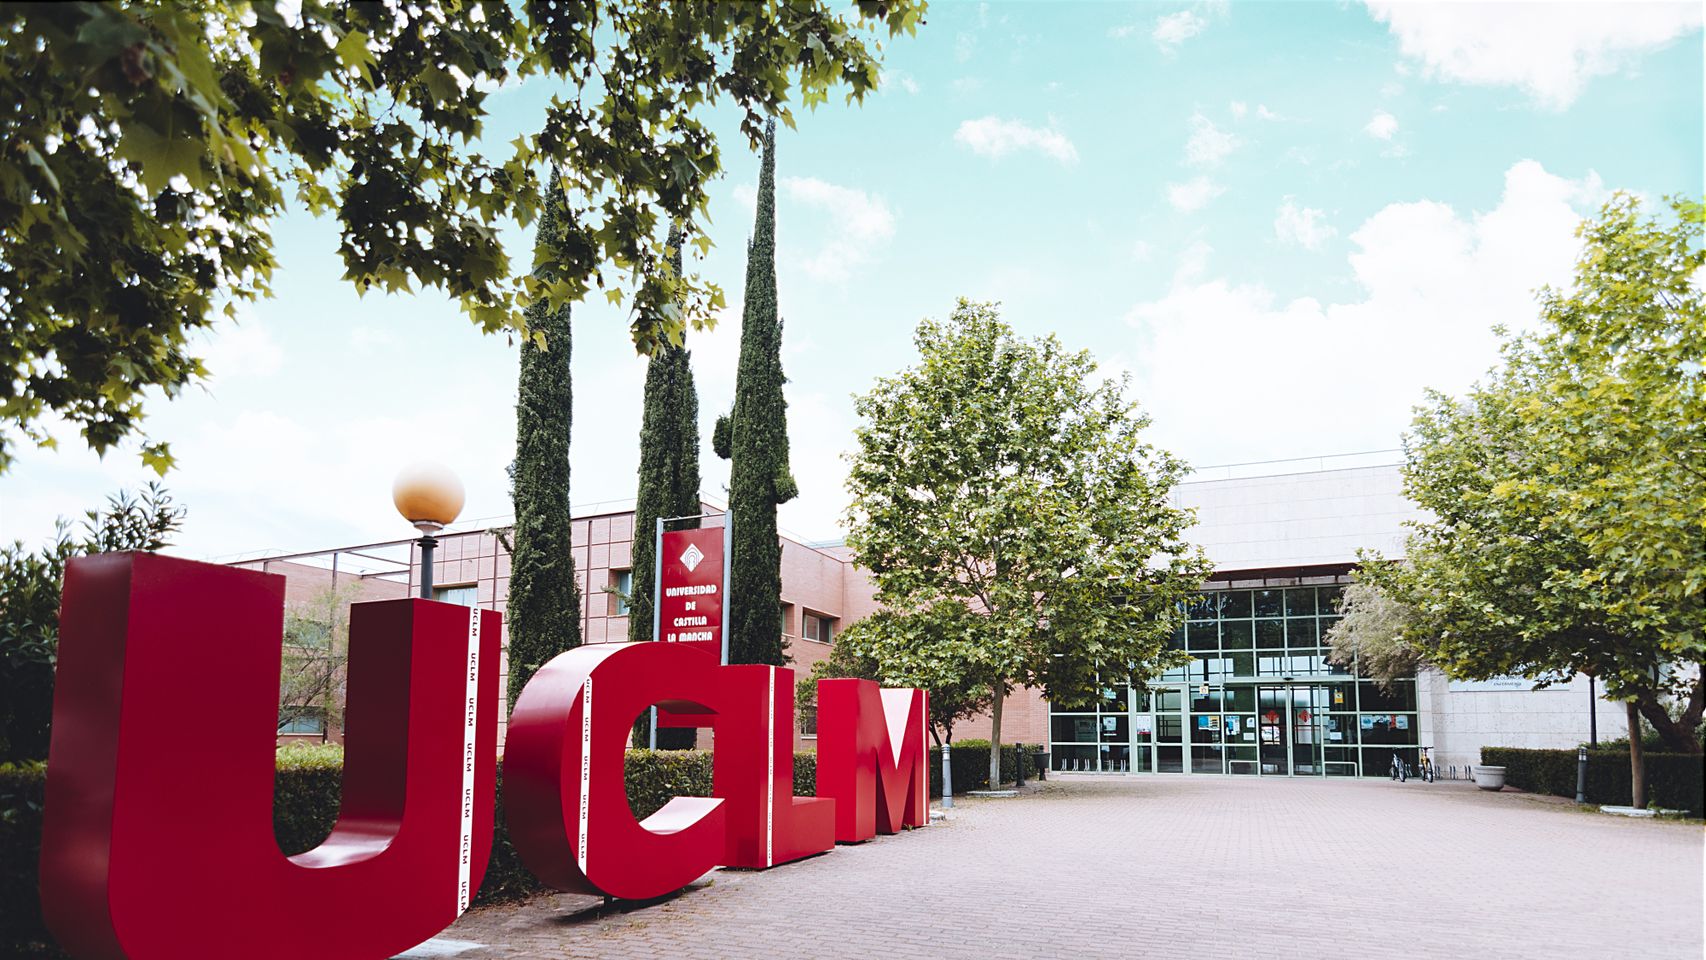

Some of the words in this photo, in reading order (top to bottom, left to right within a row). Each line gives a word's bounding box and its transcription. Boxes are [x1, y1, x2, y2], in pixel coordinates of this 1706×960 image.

[666, 585, 717, 597] UNIVERSIDAD
[685, 601, 696, 611] DE
[674, 616, 707, 627] CASTILLA
[667, 633, 676, 643] LA
[679, 631, 713, 642] MANCHA
